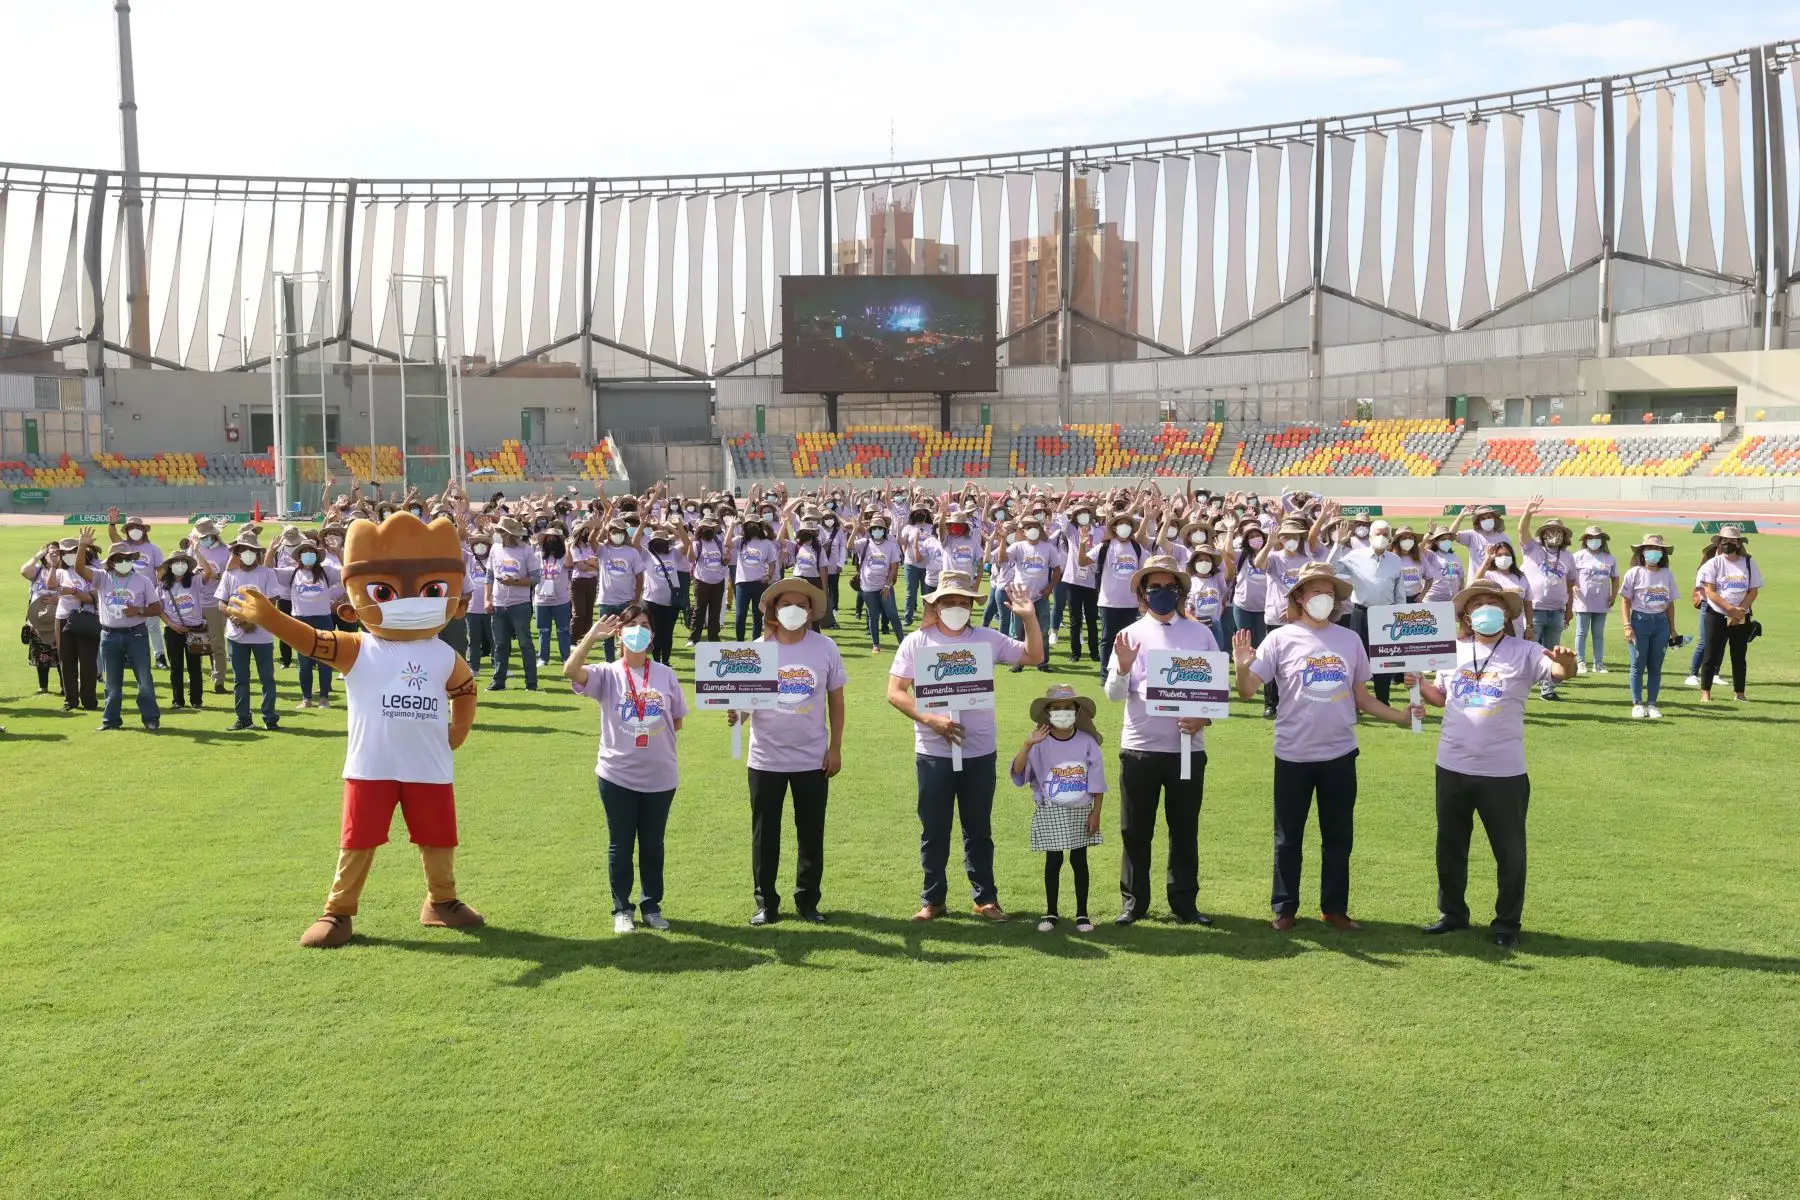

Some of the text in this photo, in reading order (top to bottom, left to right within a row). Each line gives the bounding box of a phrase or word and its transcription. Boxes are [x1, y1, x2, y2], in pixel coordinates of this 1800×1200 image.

[1378, 645, 1402, 656] Hazte
[703, 683, 737, 691] Aumenta
[922, 686, 955, 695] Aumenta
[382, 709, 415, 719] Seguimos
